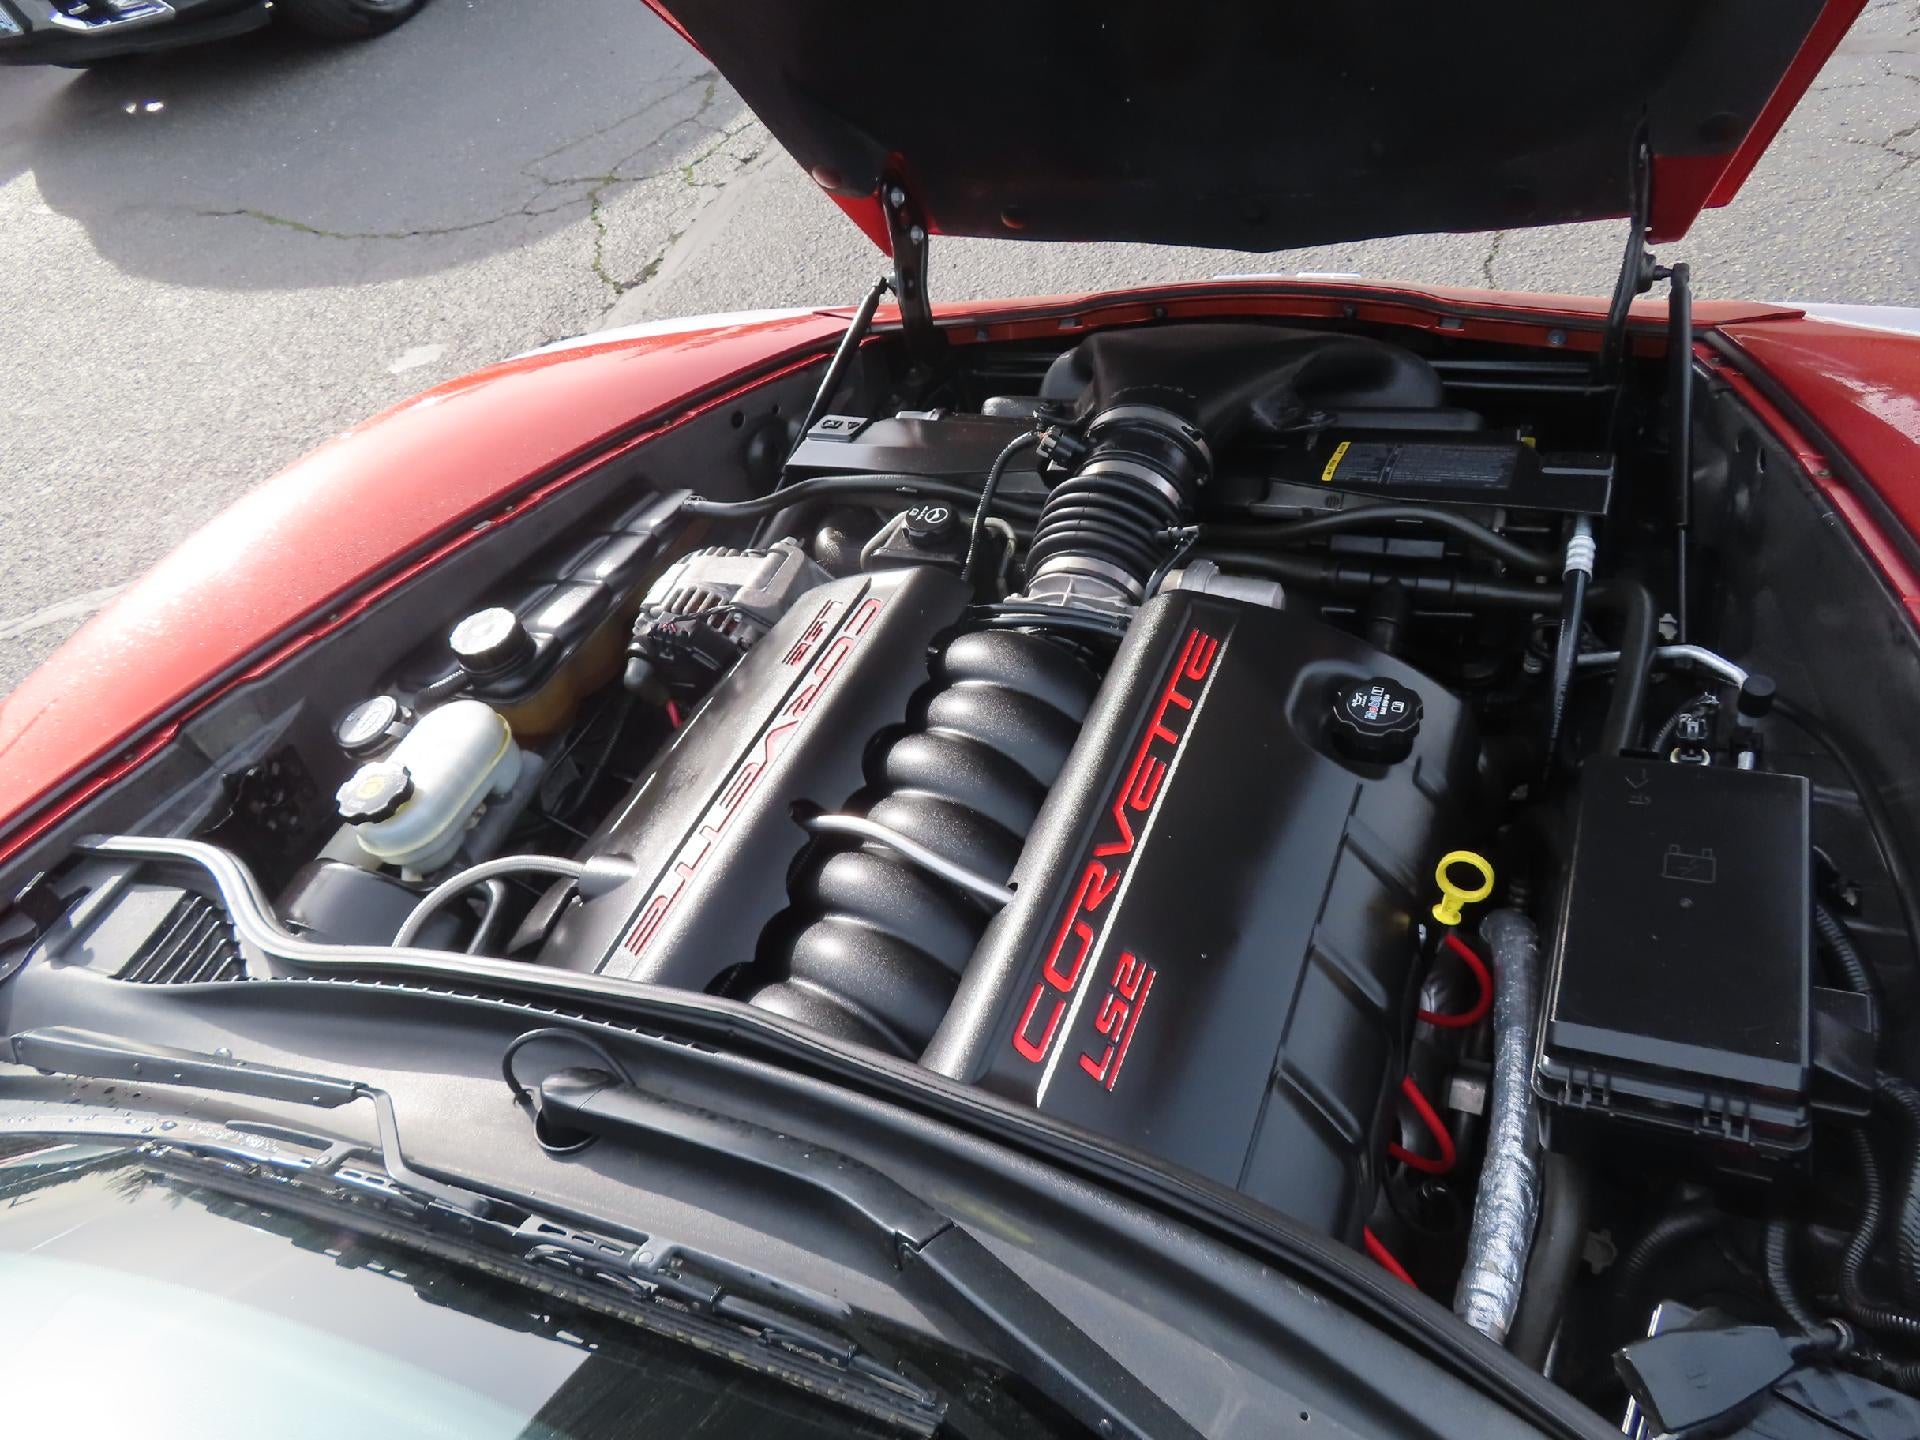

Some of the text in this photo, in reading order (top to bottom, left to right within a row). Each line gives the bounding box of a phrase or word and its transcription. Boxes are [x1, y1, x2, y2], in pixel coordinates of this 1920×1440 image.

[784, 600, 843, 666] LS2
[624, 597, 882, 957] CORVETTE
[1011, 627, 1218, 1064] CORVETTE
[1079, 951, 1147, 1082] LS2
